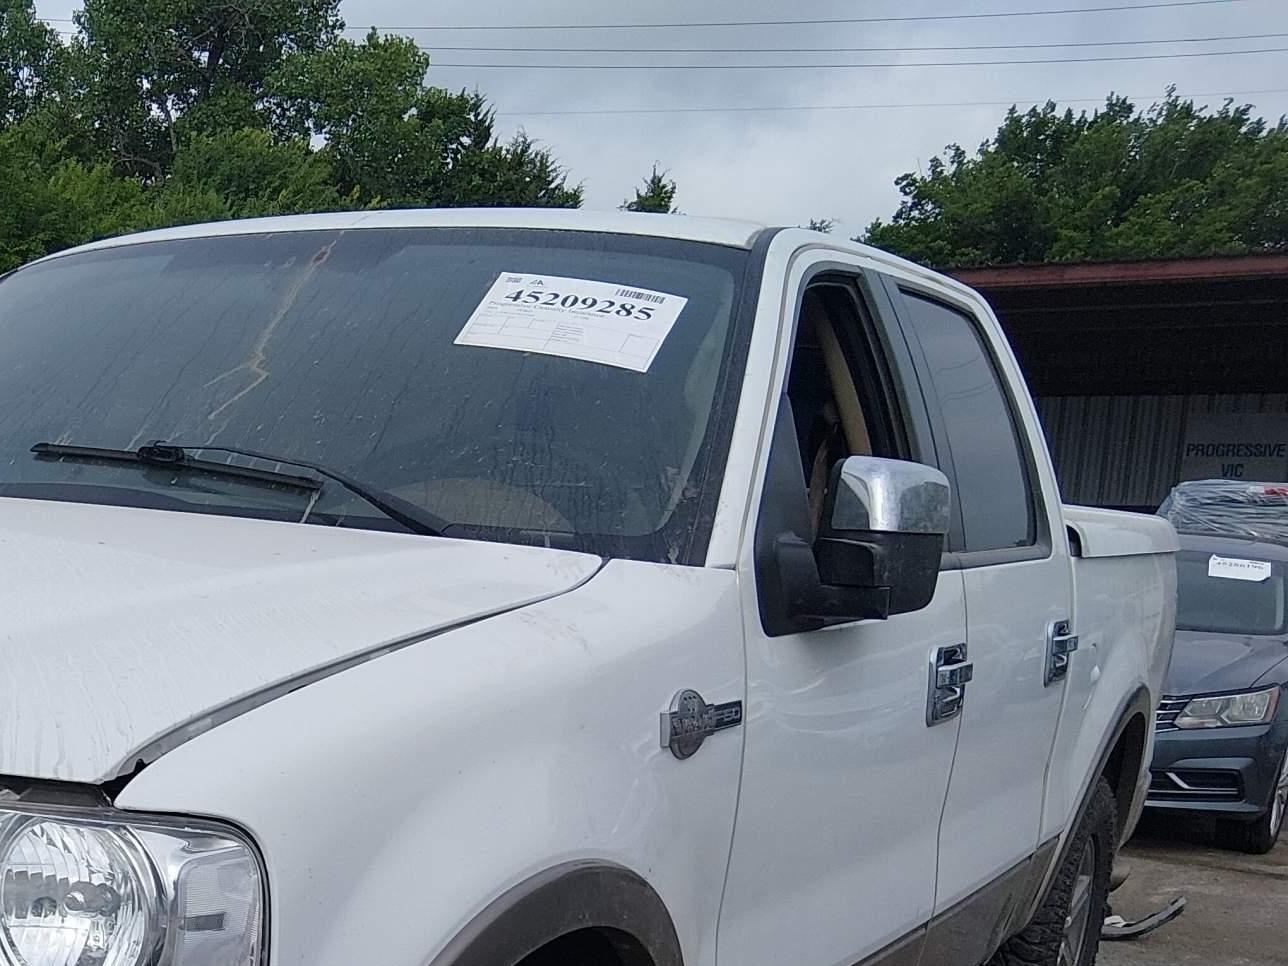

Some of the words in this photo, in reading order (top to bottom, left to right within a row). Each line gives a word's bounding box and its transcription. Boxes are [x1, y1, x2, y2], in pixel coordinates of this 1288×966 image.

[504, 289, 656, 320] 45209285
[1186, 443, 1287, 458] PROGRESSIVE
[1221, 464, 1244, 477] VIC
